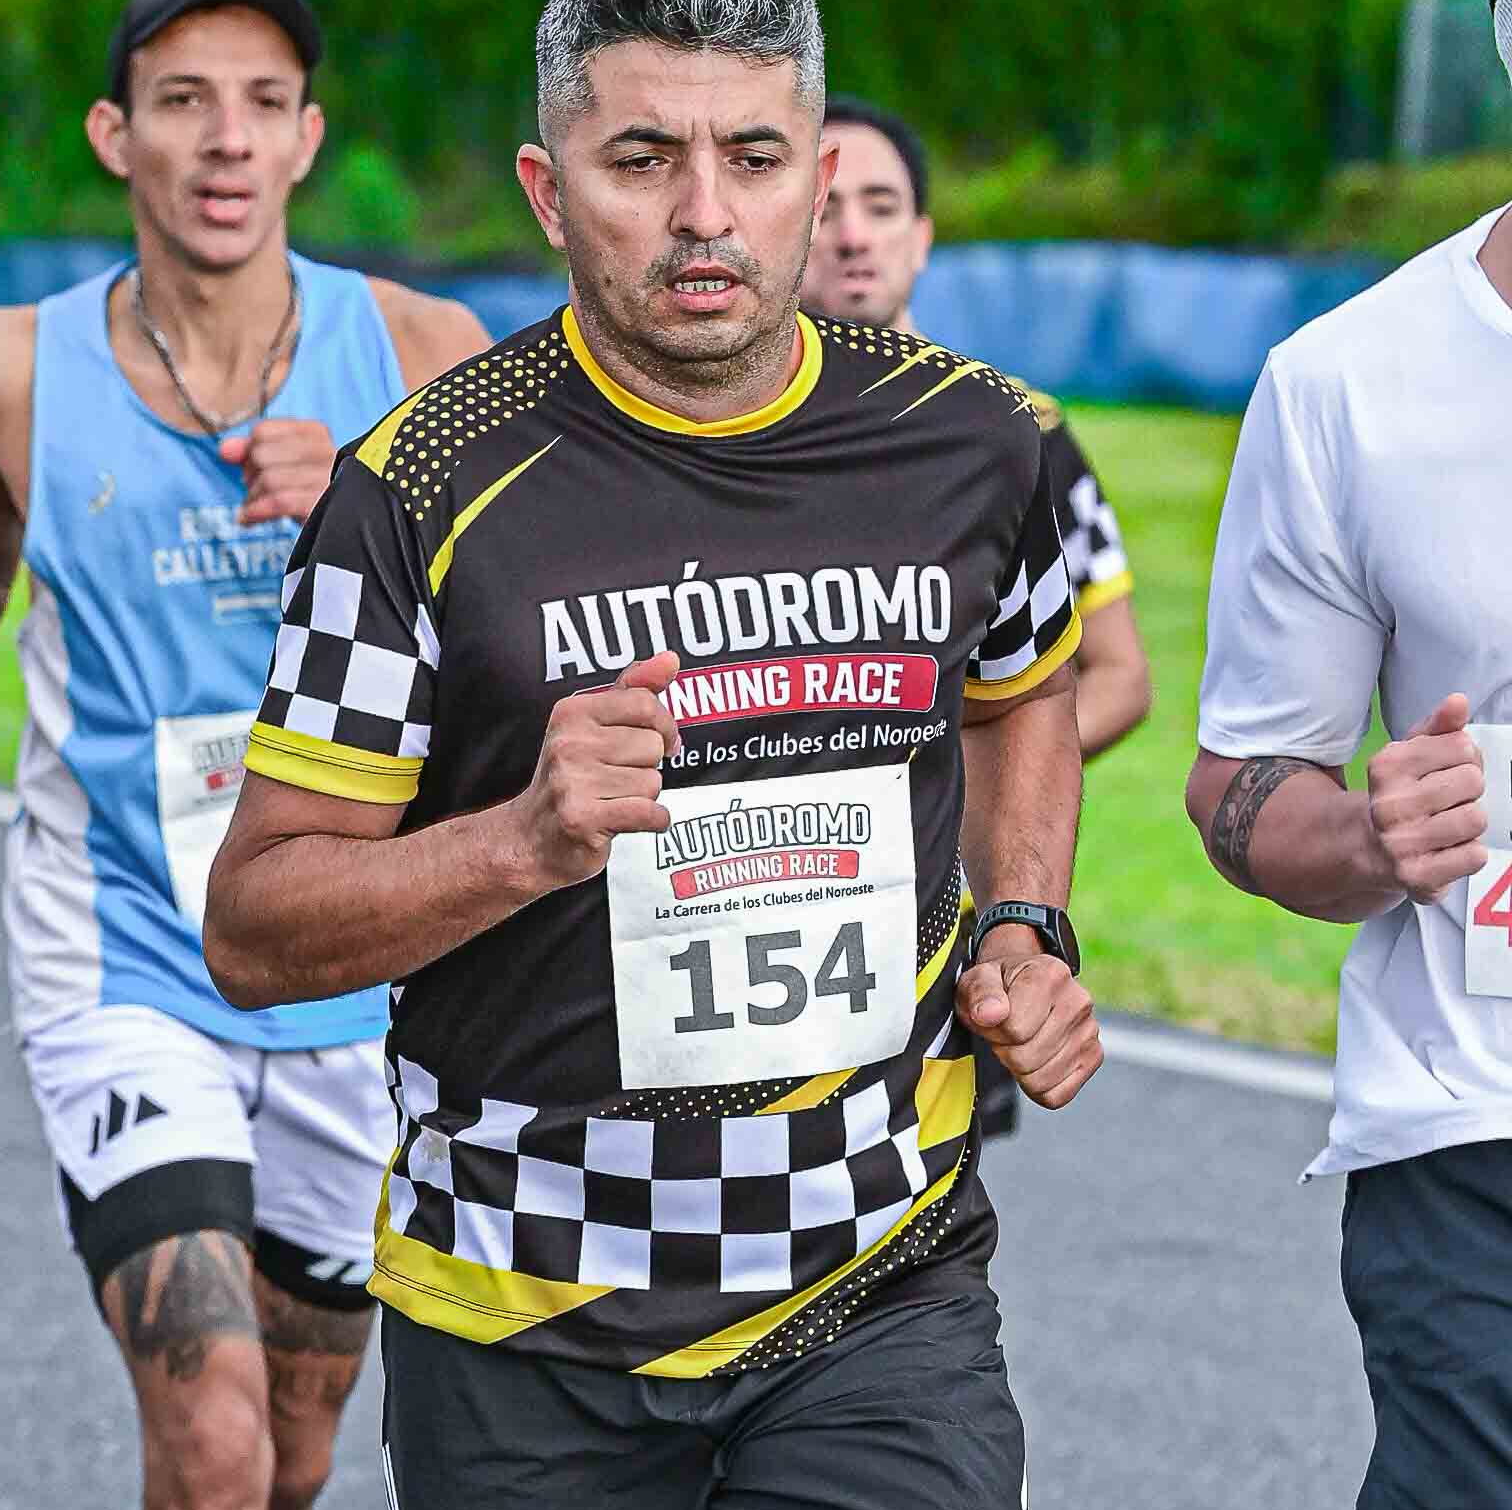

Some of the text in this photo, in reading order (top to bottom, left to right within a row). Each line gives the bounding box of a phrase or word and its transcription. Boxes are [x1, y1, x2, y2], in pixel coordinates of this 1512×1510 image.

[539, 560, 952, 683] AUTÓDROMO
[658, 661, 905, 721] NNING RACE
[670, 745, 700, 769] de
[705, 741, 738, 764] los
[743, 732, 824, 760] Clubes
[829, 724, 867, 751] del
[655, 798, 871, 871] AUTÓDROMO
[655, 883, 875, 920] La Carrera de los Clubes del Noroeste
[693, 852, 841, 893] RUNNING RACE
[669, 921, 876, 1034] 154
